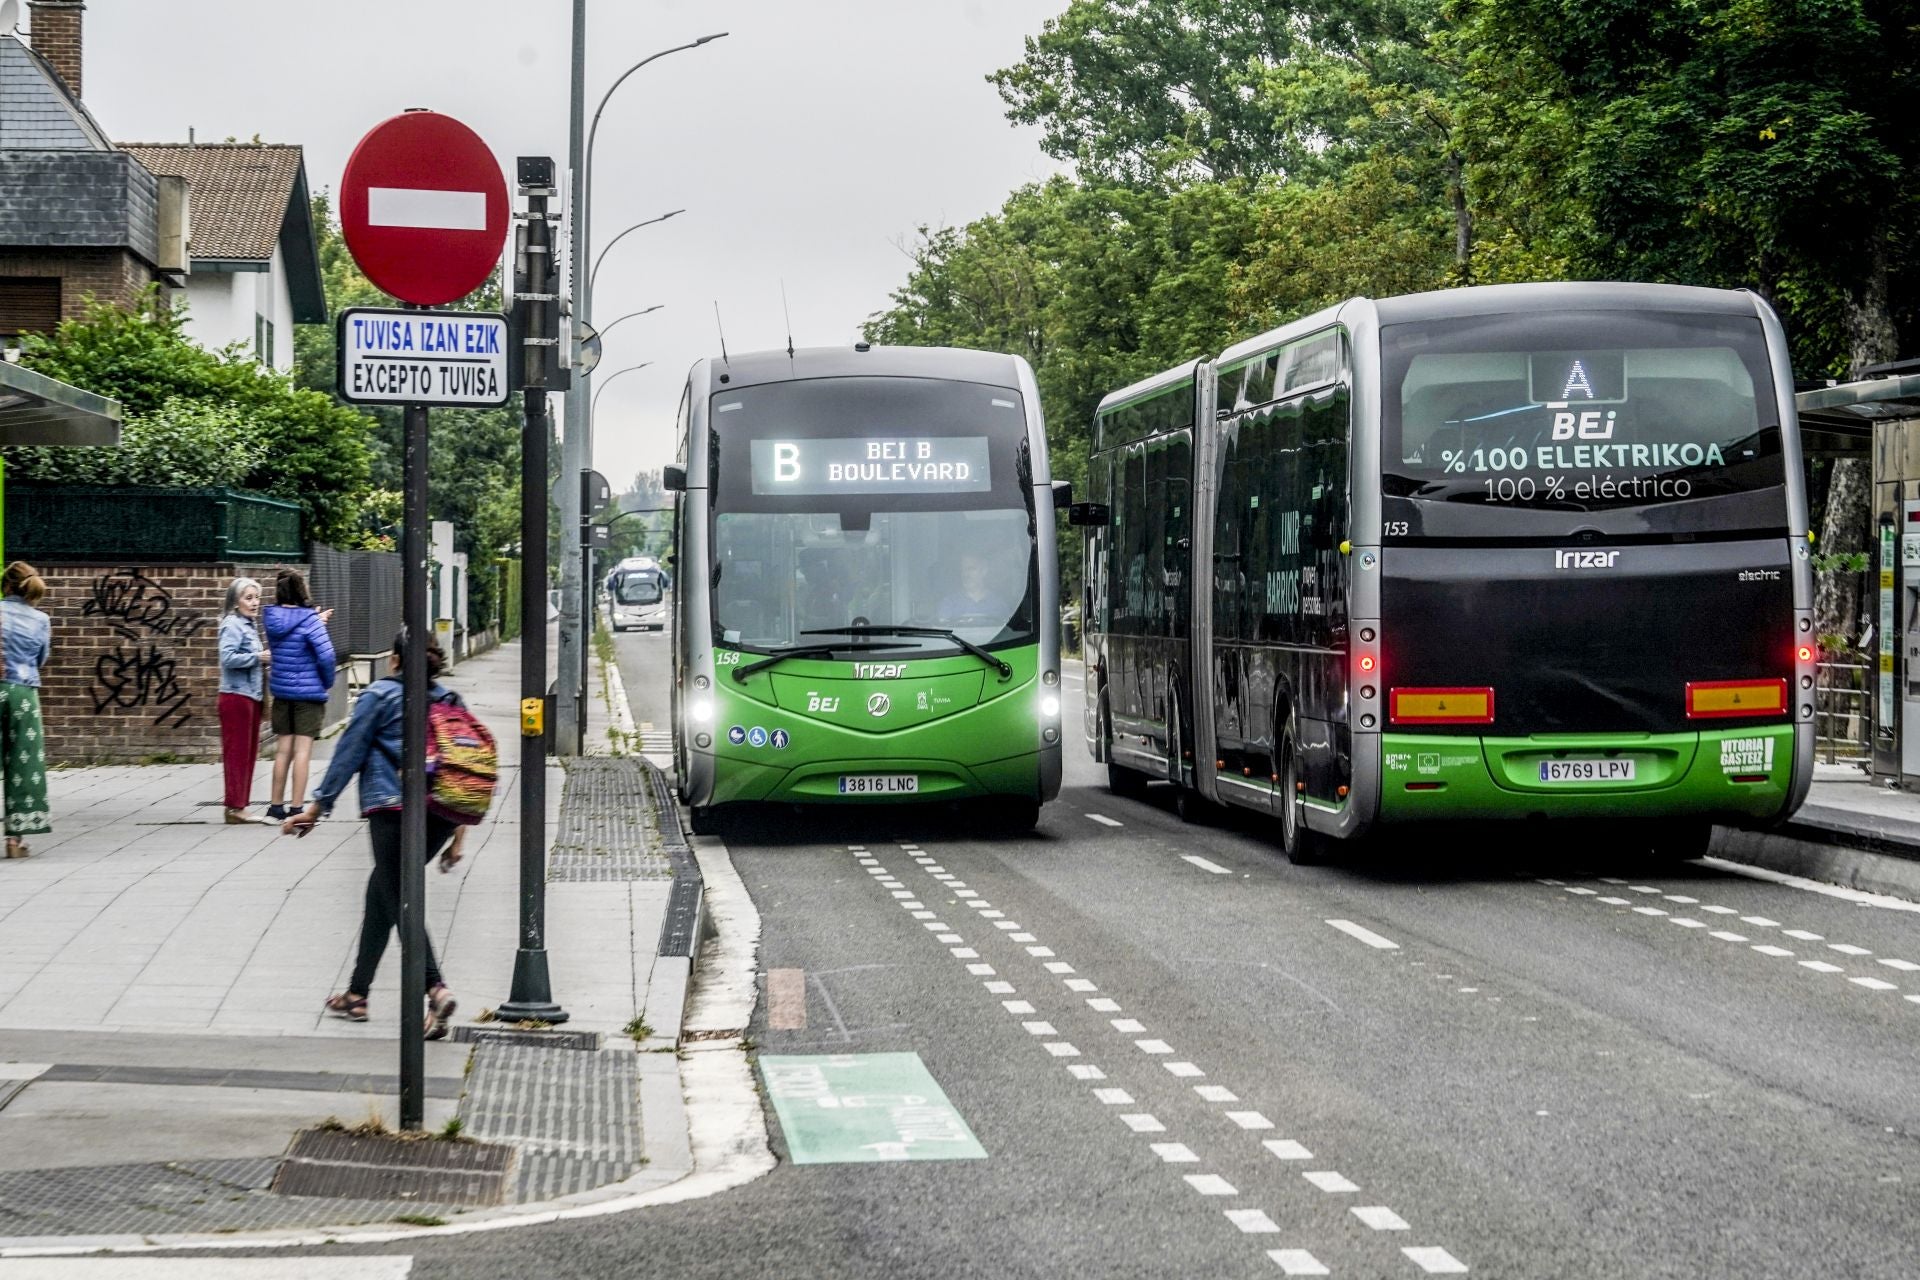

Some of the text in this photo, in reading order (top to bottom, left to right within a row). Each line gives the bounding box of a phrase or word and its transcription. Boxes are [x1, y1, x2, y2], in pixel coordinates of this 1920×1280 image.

[354, 320, 500, 354] TUVISA IZAN EZIK
[354, 363, 498, 396] EXCEPTO TUVISA
[1562, 360, 1593, 399] A
[866, 441, 931, 460] BEI B
[1441, 443, 1726, 474] % 100 ELEKTRIKOA
[773, 443, 801, 482] B
[829, 463, 970, 481] BOULEVARD
[1484, 474, 1692, 502] 100 % eléctrico
[1281, 510, 1300, 556] UNIR
[1384, 521, 1409, 536] 153
[1555, 550, 1620, 569] Irizar
[1266, 569, 1299, 615] BARRIOS
[716, 652, 740, 665] 158
[854, 662, 907, 679] Irizar
[1721, 738, 1764, 753] VITORIA
[1720, 751, 1764, 766] GASTEIZ
[1551, 762, 1630, 779] 6769 LPV
[849, 778, 914, 792] 3816 LNC
